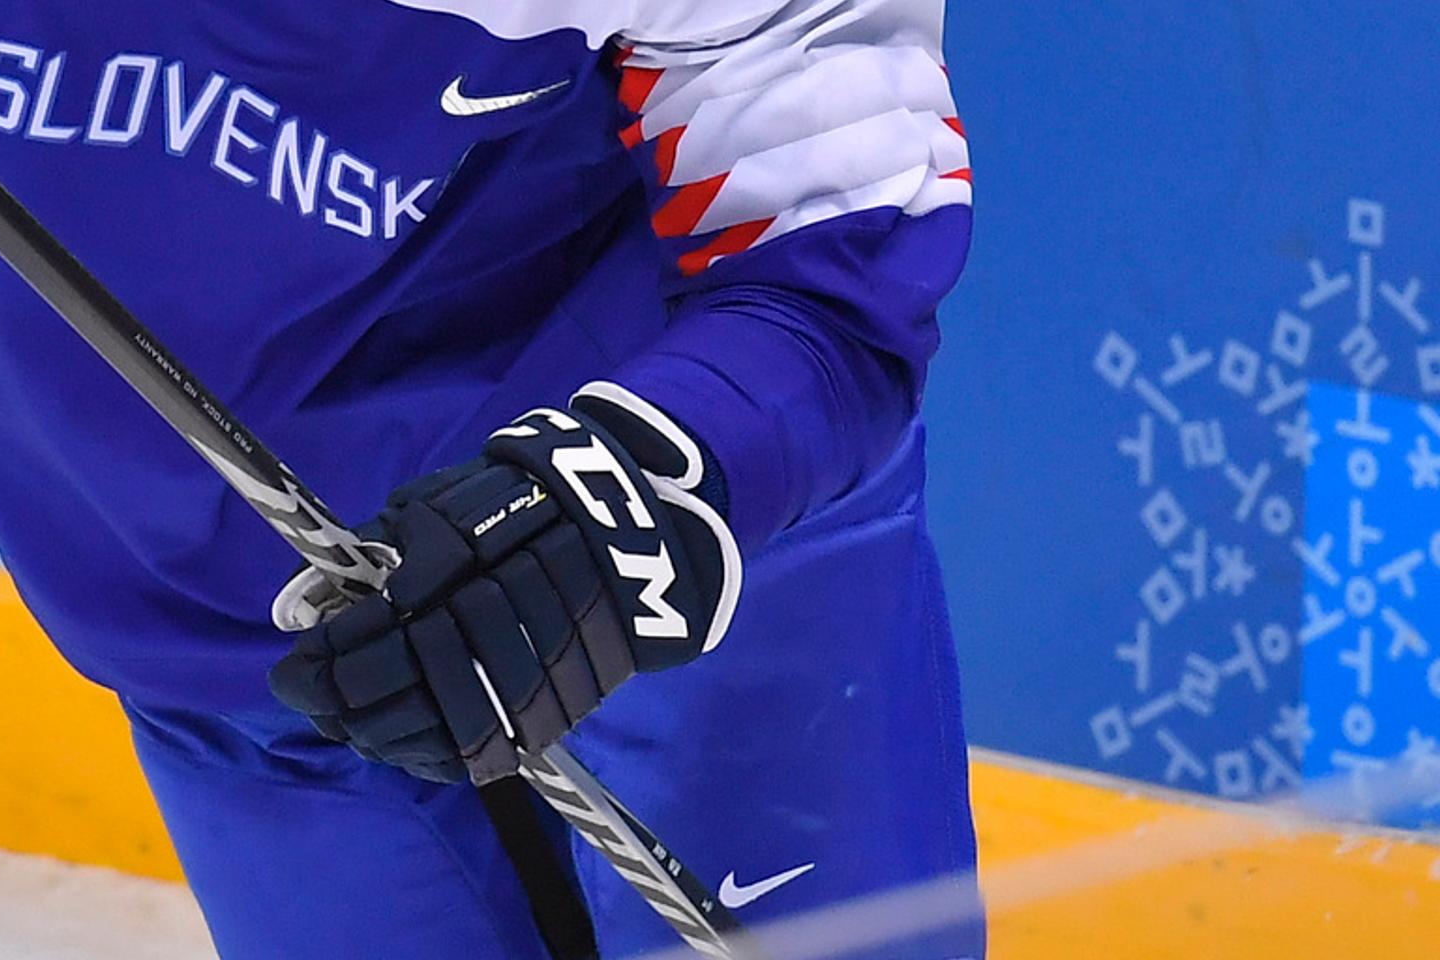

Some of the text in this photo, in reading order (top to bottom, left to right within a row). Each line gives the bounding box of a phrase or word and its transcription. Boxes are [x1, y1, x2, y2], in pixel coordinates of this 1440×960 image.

[135, 333, 181, 381] WARRANTY
[183, 381, 198, 399] NO
[233, 431, 253, 454] PRO
